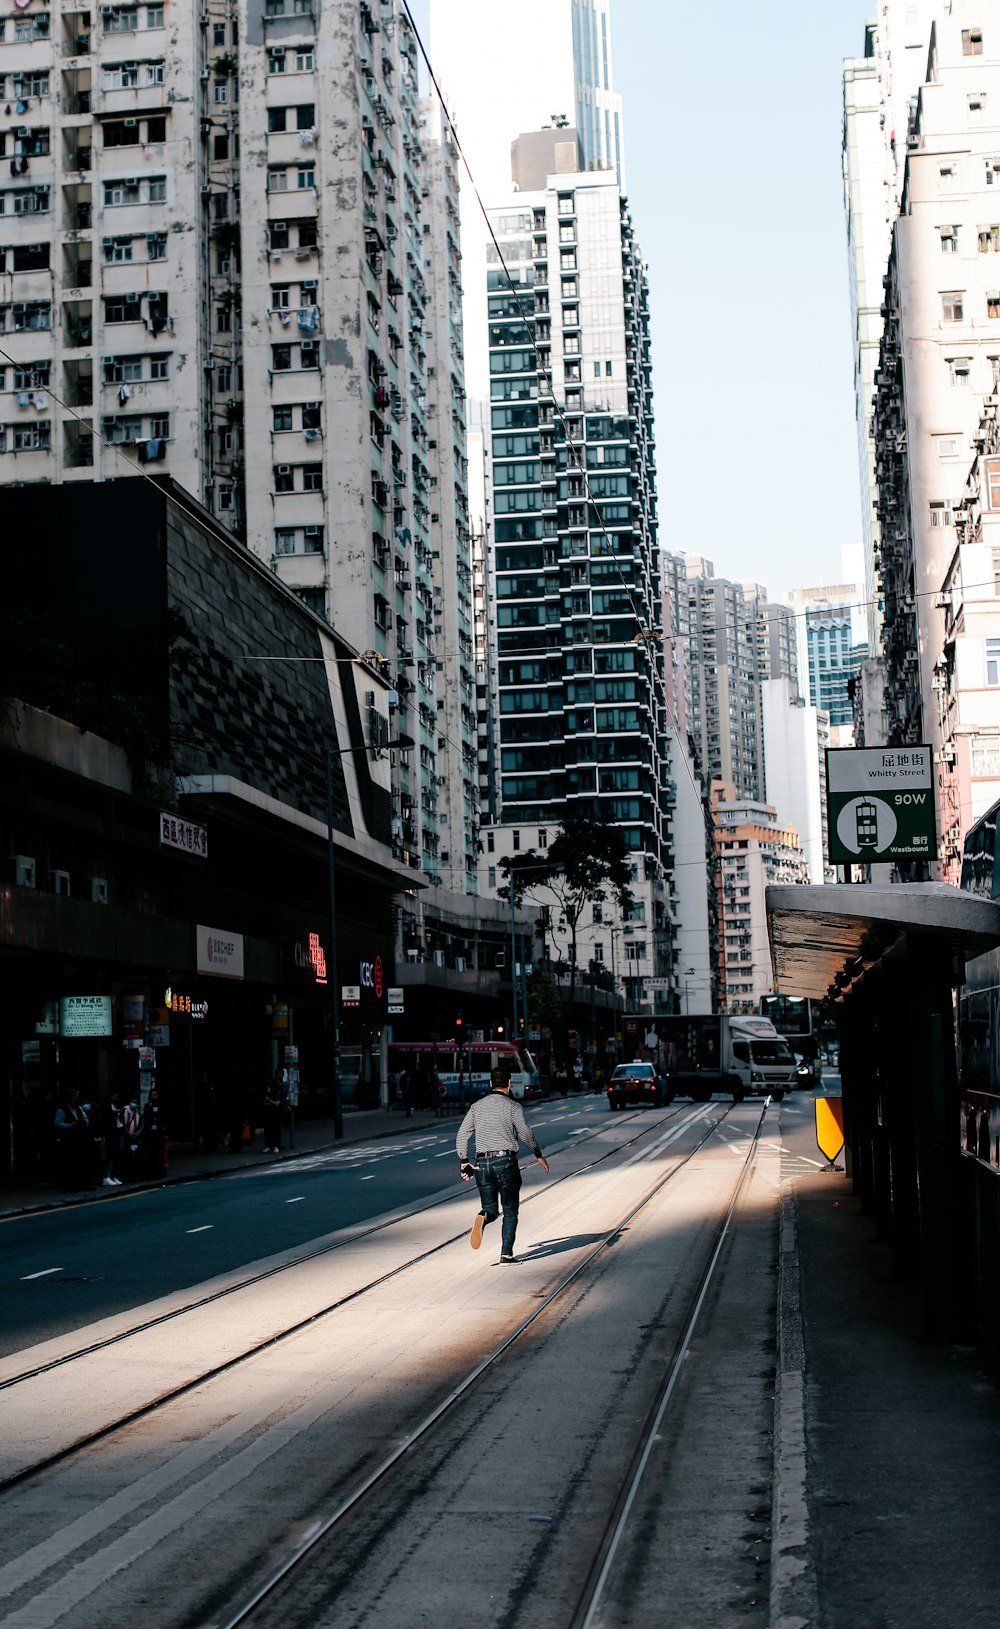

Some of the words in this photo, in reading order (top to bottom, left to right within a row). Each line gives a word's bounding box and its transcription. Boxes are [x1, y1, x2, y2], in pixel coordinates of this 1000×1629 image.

[882, 753, 924, 767] 屈地街
[868, 769, 897, 778] Whitty
[899, 769, 925, 777] Street
[894, 793, 926, 805] 90W
[912, 836, 928, 845] 西行
[360, 960, 374, 987] ICBC
